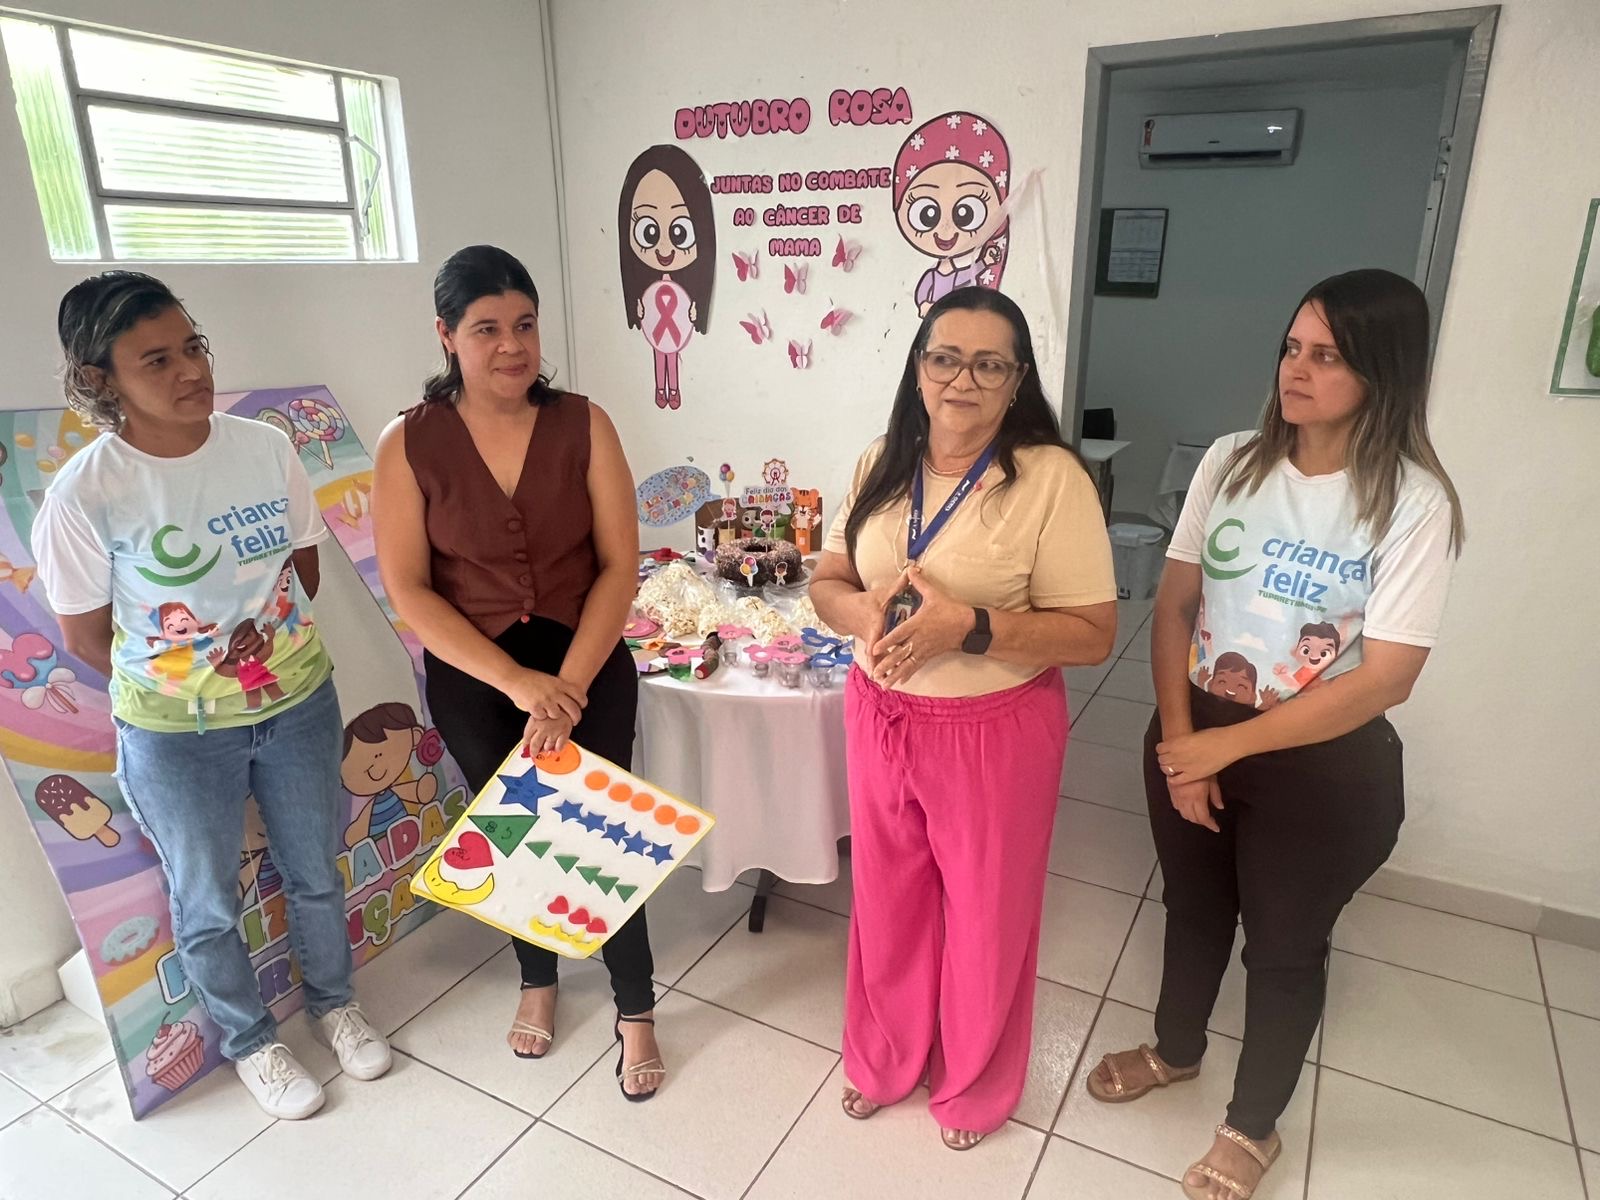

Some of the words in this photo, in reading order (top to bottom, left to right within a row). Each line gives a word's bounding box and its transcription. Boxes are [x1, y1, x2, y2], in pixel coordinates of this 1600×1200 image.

[828, 86, 913, 127] ROSA
[710, 174, 774, 194] JUNTAS
[778, 172, 803, 192] NO
[805, 167, 892, 191] COMBATE
[733, 207, 755, 226] AO
[762, 203, 831, 227] CÂNCER
[837, 203, 863, 224] DE
[768, 237, 822, 257] MAMA
[230, 525, 290, 558] feliz
[1261, 538, 1367, 585] criança
[1262, 564, 1329, 603] feliz
